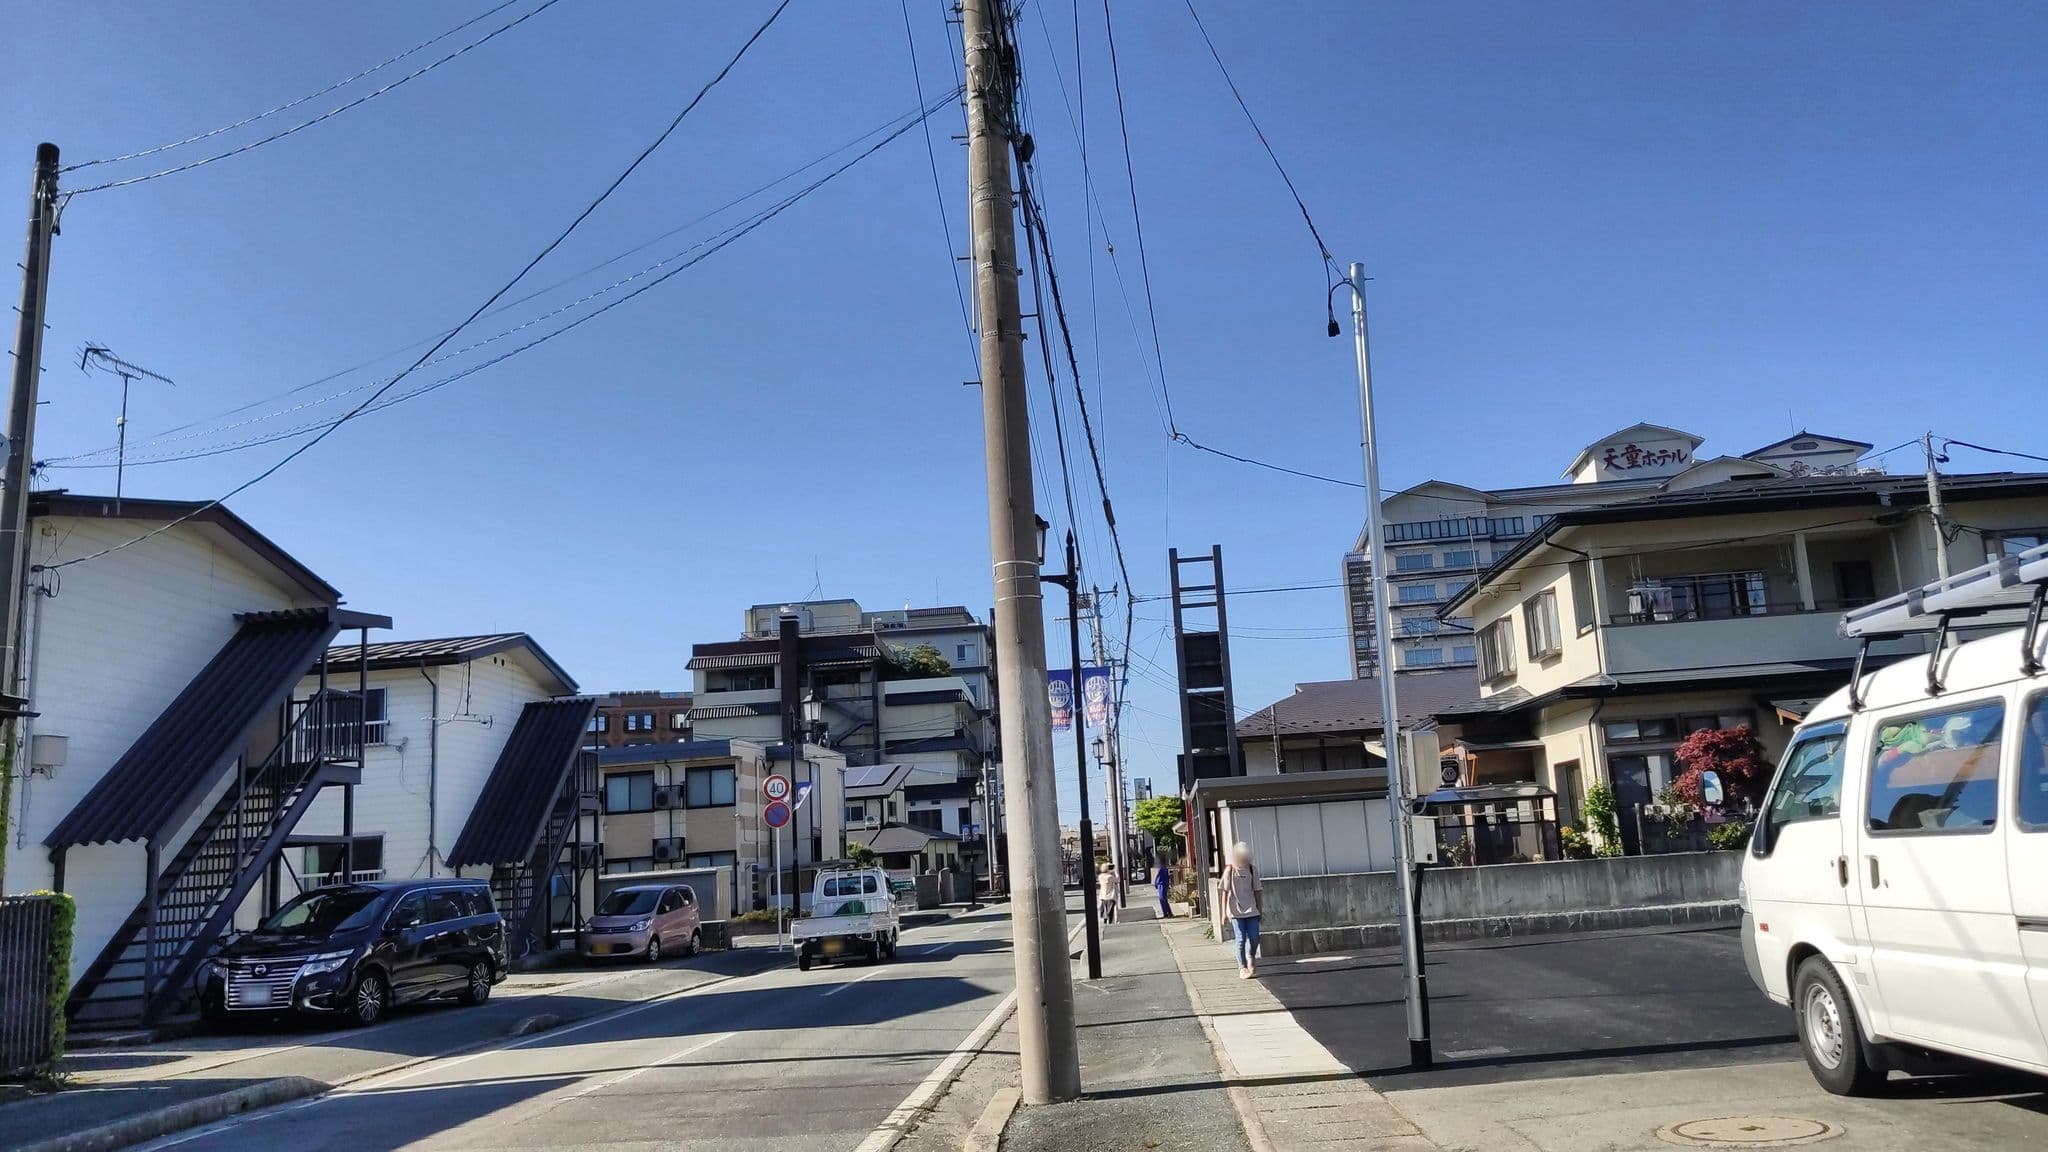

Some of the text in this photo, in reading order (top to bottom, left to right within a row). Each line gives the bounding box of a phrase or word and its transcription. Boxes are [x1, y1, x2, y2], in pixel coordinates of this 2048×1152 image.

[1603, 444, 1688, 471] 天童ホテル
[770, 782, 784, 794] 40
